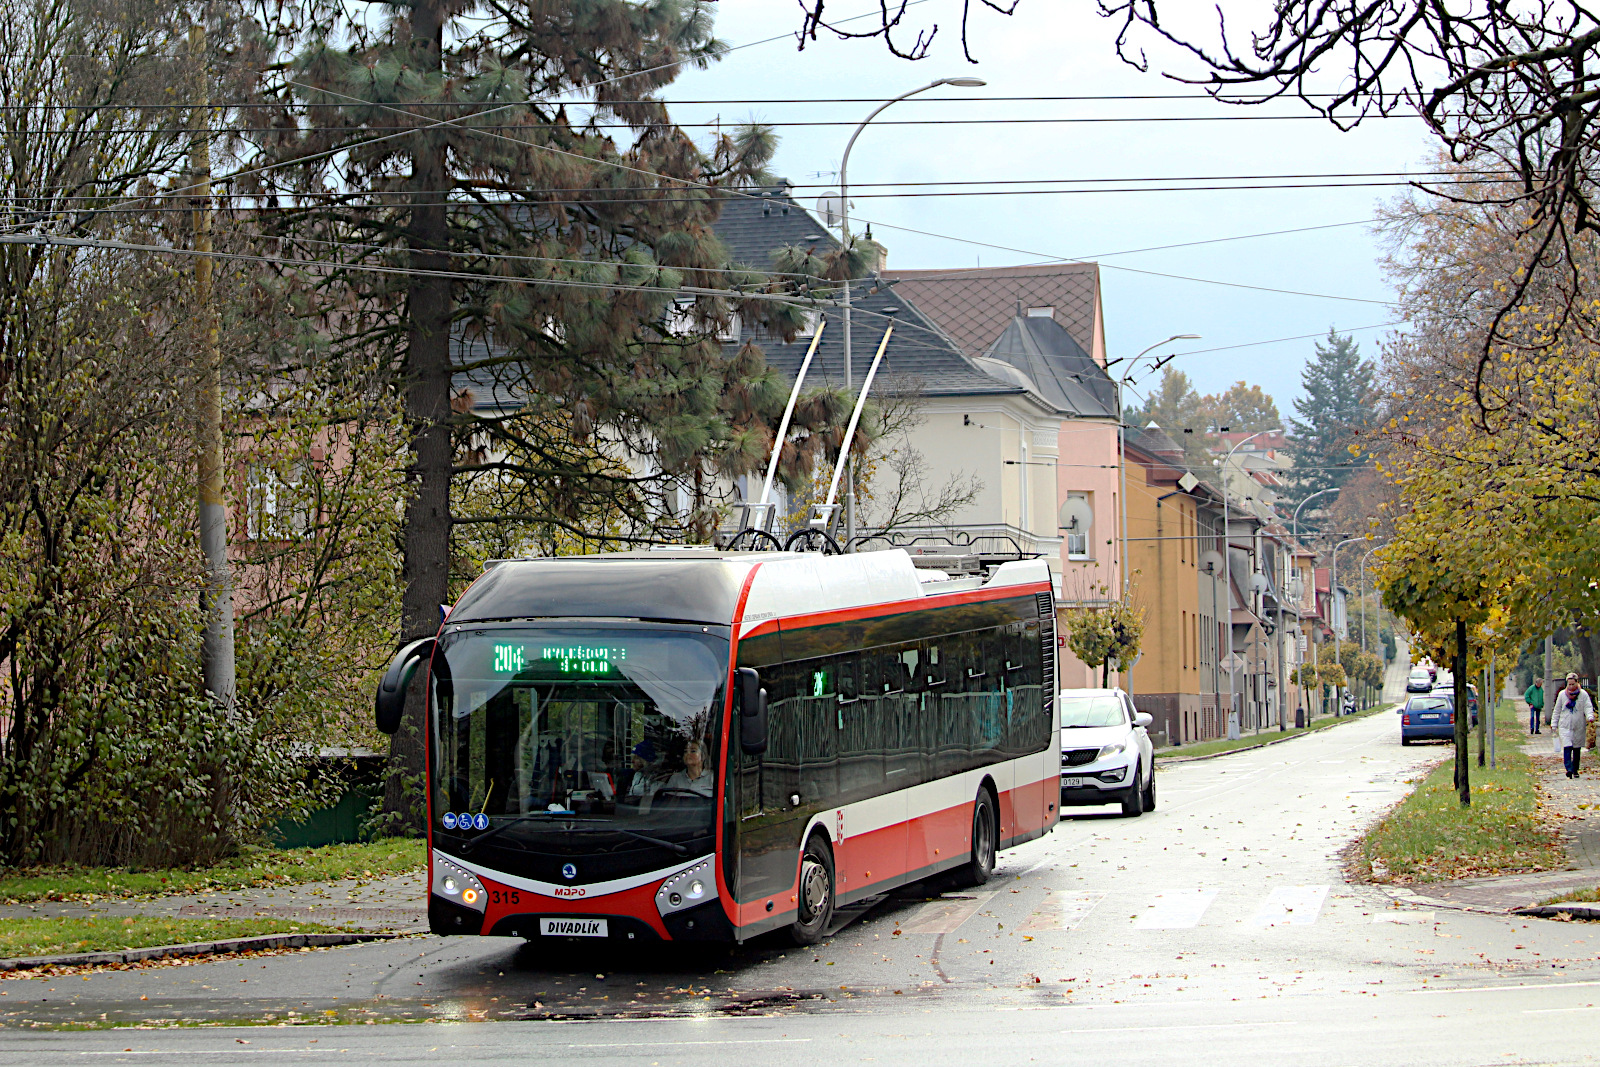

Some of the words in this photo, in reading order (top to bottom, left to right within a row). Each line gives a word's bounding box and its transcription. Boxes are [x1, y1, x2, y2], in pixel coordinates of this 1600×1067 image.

[492, 890, 520, 904] 315
[554, 888, 586, 896] MDPO
[547, 920, 601, 934] DIVADLÍK
